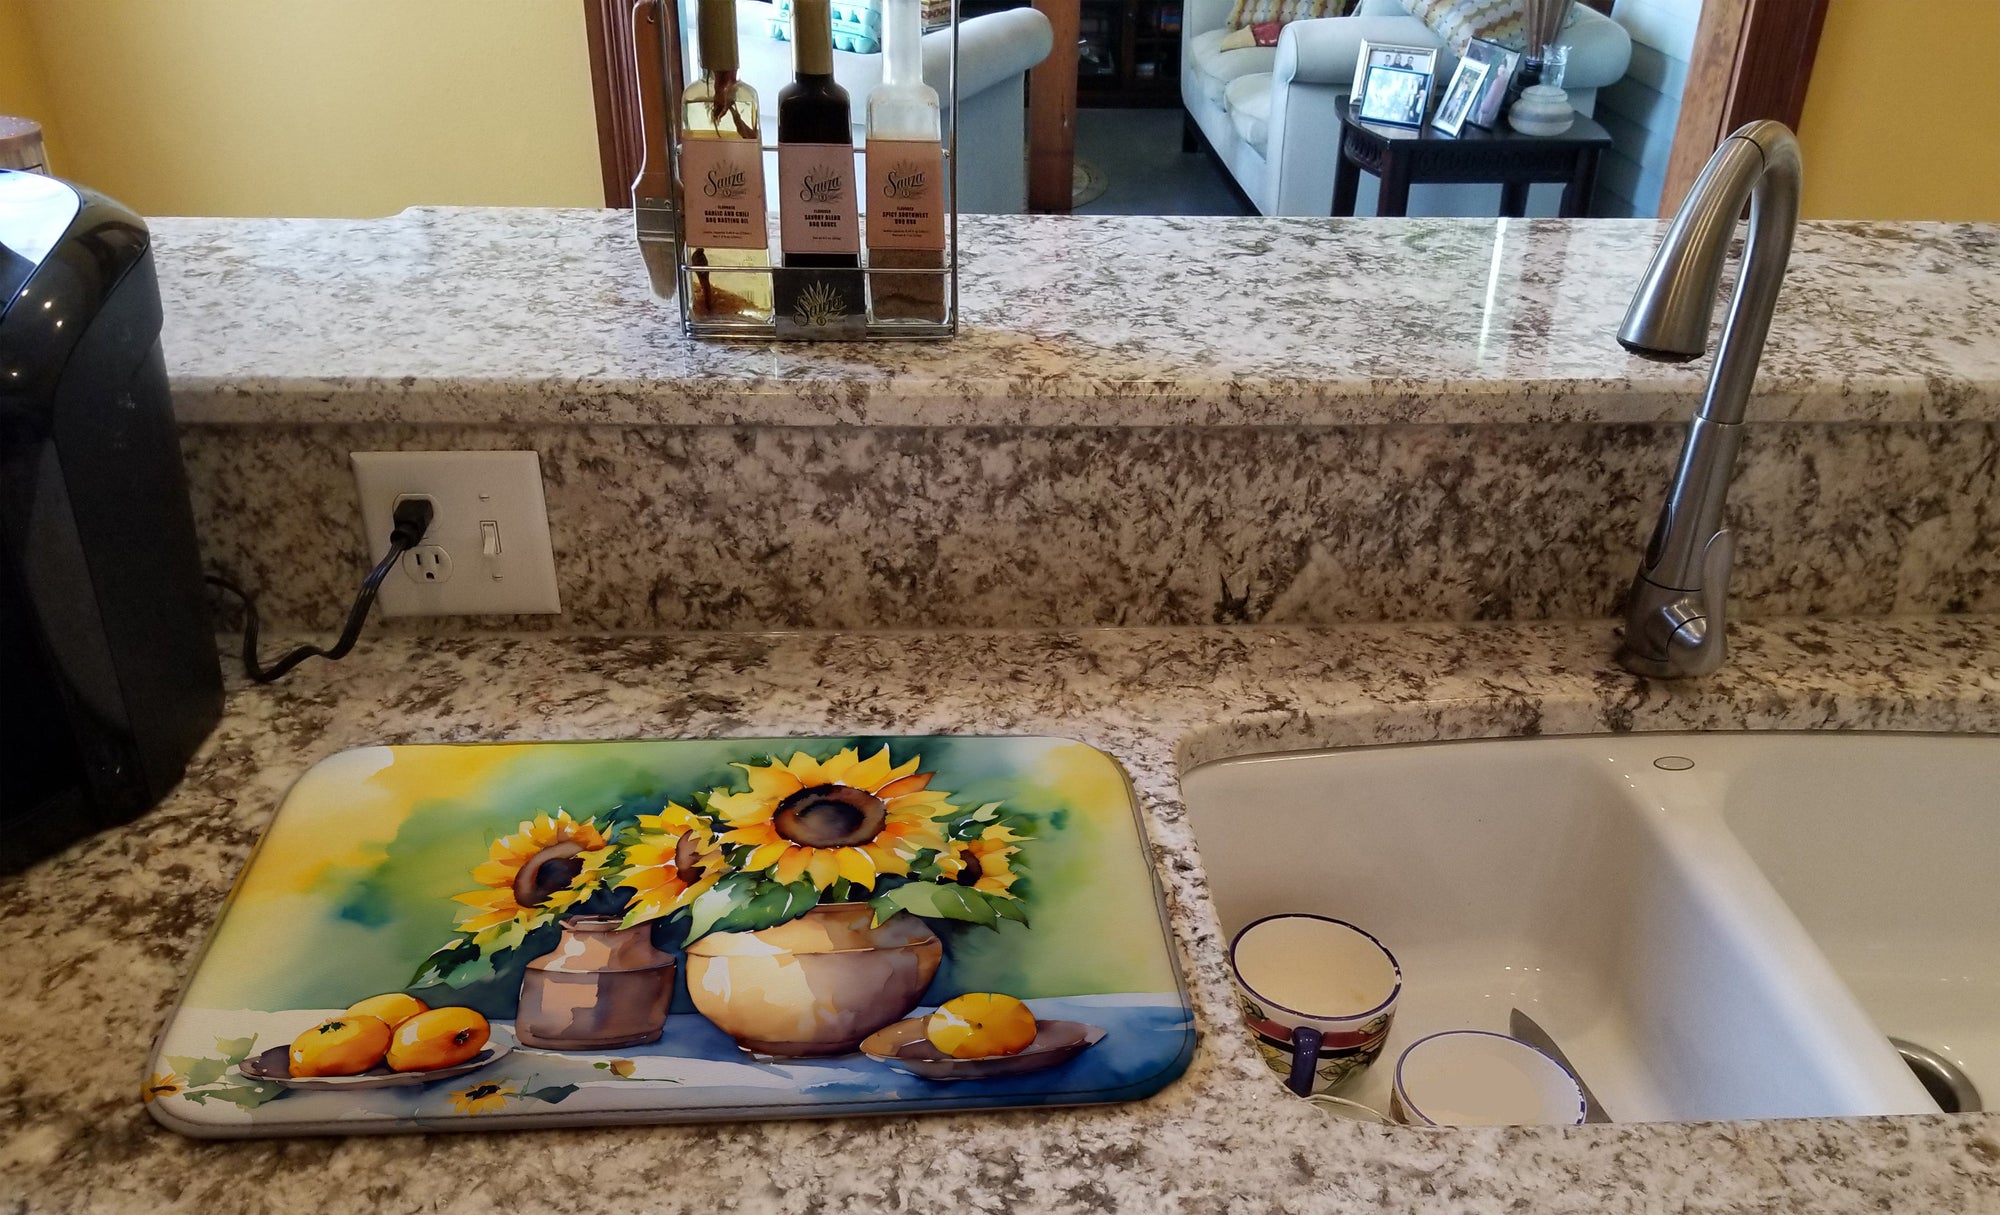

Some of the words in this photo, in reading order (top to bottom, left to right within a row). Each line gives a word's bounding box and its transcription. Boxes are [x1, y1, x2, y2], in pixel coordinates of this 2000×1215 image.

[704, 170, 745, 197] Sauza
[800, 175, 841, 202] Sauza
[884, 171, 925, 198] Sauza
[793, 295, 844, 326] Sauza
